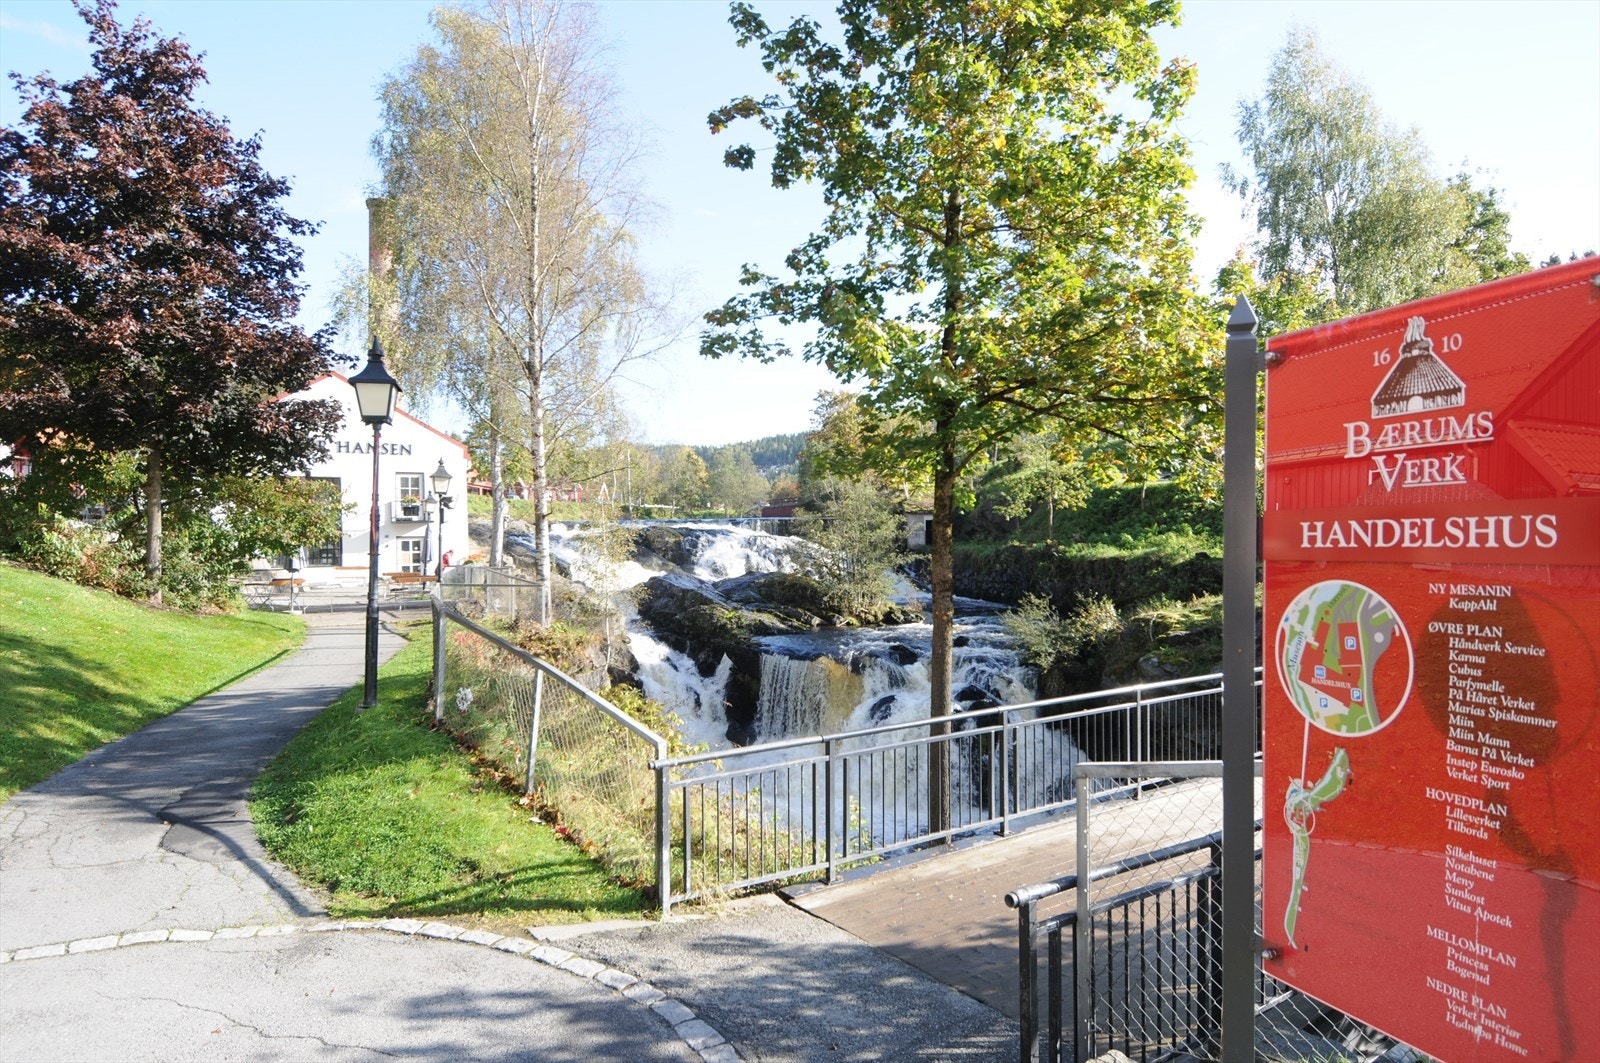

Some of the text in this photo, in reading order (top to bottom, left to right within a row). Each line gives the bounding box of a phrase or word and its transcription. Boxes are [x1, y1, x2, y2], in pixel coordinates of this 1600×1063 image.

[1372, 333, 1462, 367] 16 10
[1343, 411, 1494, 459] BÆRUMS
[336, 440, 412, 456] HANSEN
[1371, 453, 1466, 492] VERK
[1300, 513, 1558, 548] HANDELSHUS
[1428, 583, 1512, 597] NY MESANIN
[1449, 598, 1497, 612] KappAhl
[1428, 621, 1503, 638] ØVRE PLAN
[1448, 650, 1486, 664] Karma
[1449, 637, 1546, 657] Håndverk Service
[1448, 663, 1482, 677] Cubus
[1448, 675, 1505, 693] Parfymelle
[1448, 688, 1536, 711] På Håret Verket
[1448, 700, 1558, 729] Marias Spiskammer
[1448, 713, 1475, 728] Miin
[1448, 726, 1511, 749] Miin Mann
[1446, 739, 1535, 768] Barna På Verket
[1446, 753, 1525, 780] Instep Eurosko
[1446, 766, 1510, 790] Verket Sport
[1425, 787, 1508, 817] HOVEDPLAN
[1446, 805, 1501, 829] Lilleverket
[1446, 818, 1488, 839] Tilbords
[1445, 844, 1497, 868] Silkehuset
[1445, 856, 1495, 881] Notabene
[1445, 869, 1475, 889] Meny
[1444, 882, 1485, 905] Sunkost
[1444, 895, 1512, 928] Vitus Apotek
[1427, 925, 1516, 968] MELLOMPLAN
[1447, 946, 1489, 971] Princess
[1447, 959, 1490, 986] Bogerud
[1426, 976, 1507, 1019] NEDRE PLAN
[1446, 998, 1477, 1020] Verket
[1494, 1032, 1528, 1056] Home
